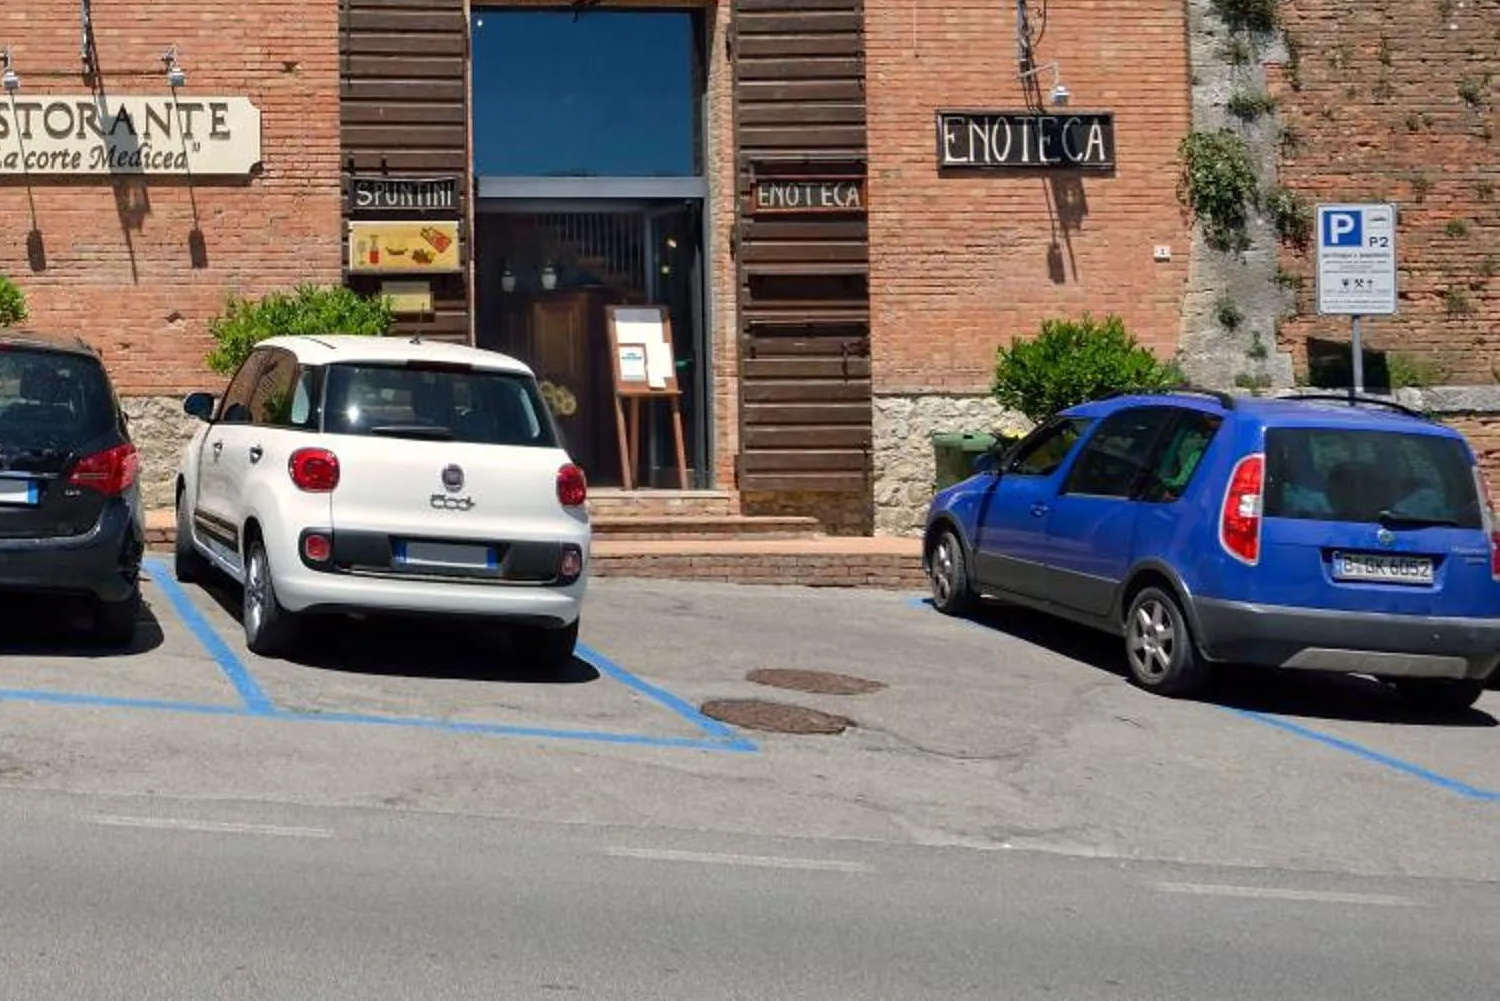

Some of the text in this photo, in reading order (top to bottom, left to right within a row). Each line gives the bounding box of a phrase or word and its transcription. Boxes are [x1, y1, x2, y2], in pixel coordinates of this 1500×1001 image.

[943, 116, 1106, 163] ENOTECA
[24, 148, 81, 170] corte
[355, 182, 452, 207] SPUNTINI
[757, 183, 860, 207] ENOTECA
[1330, 213, 1355, 244] P
